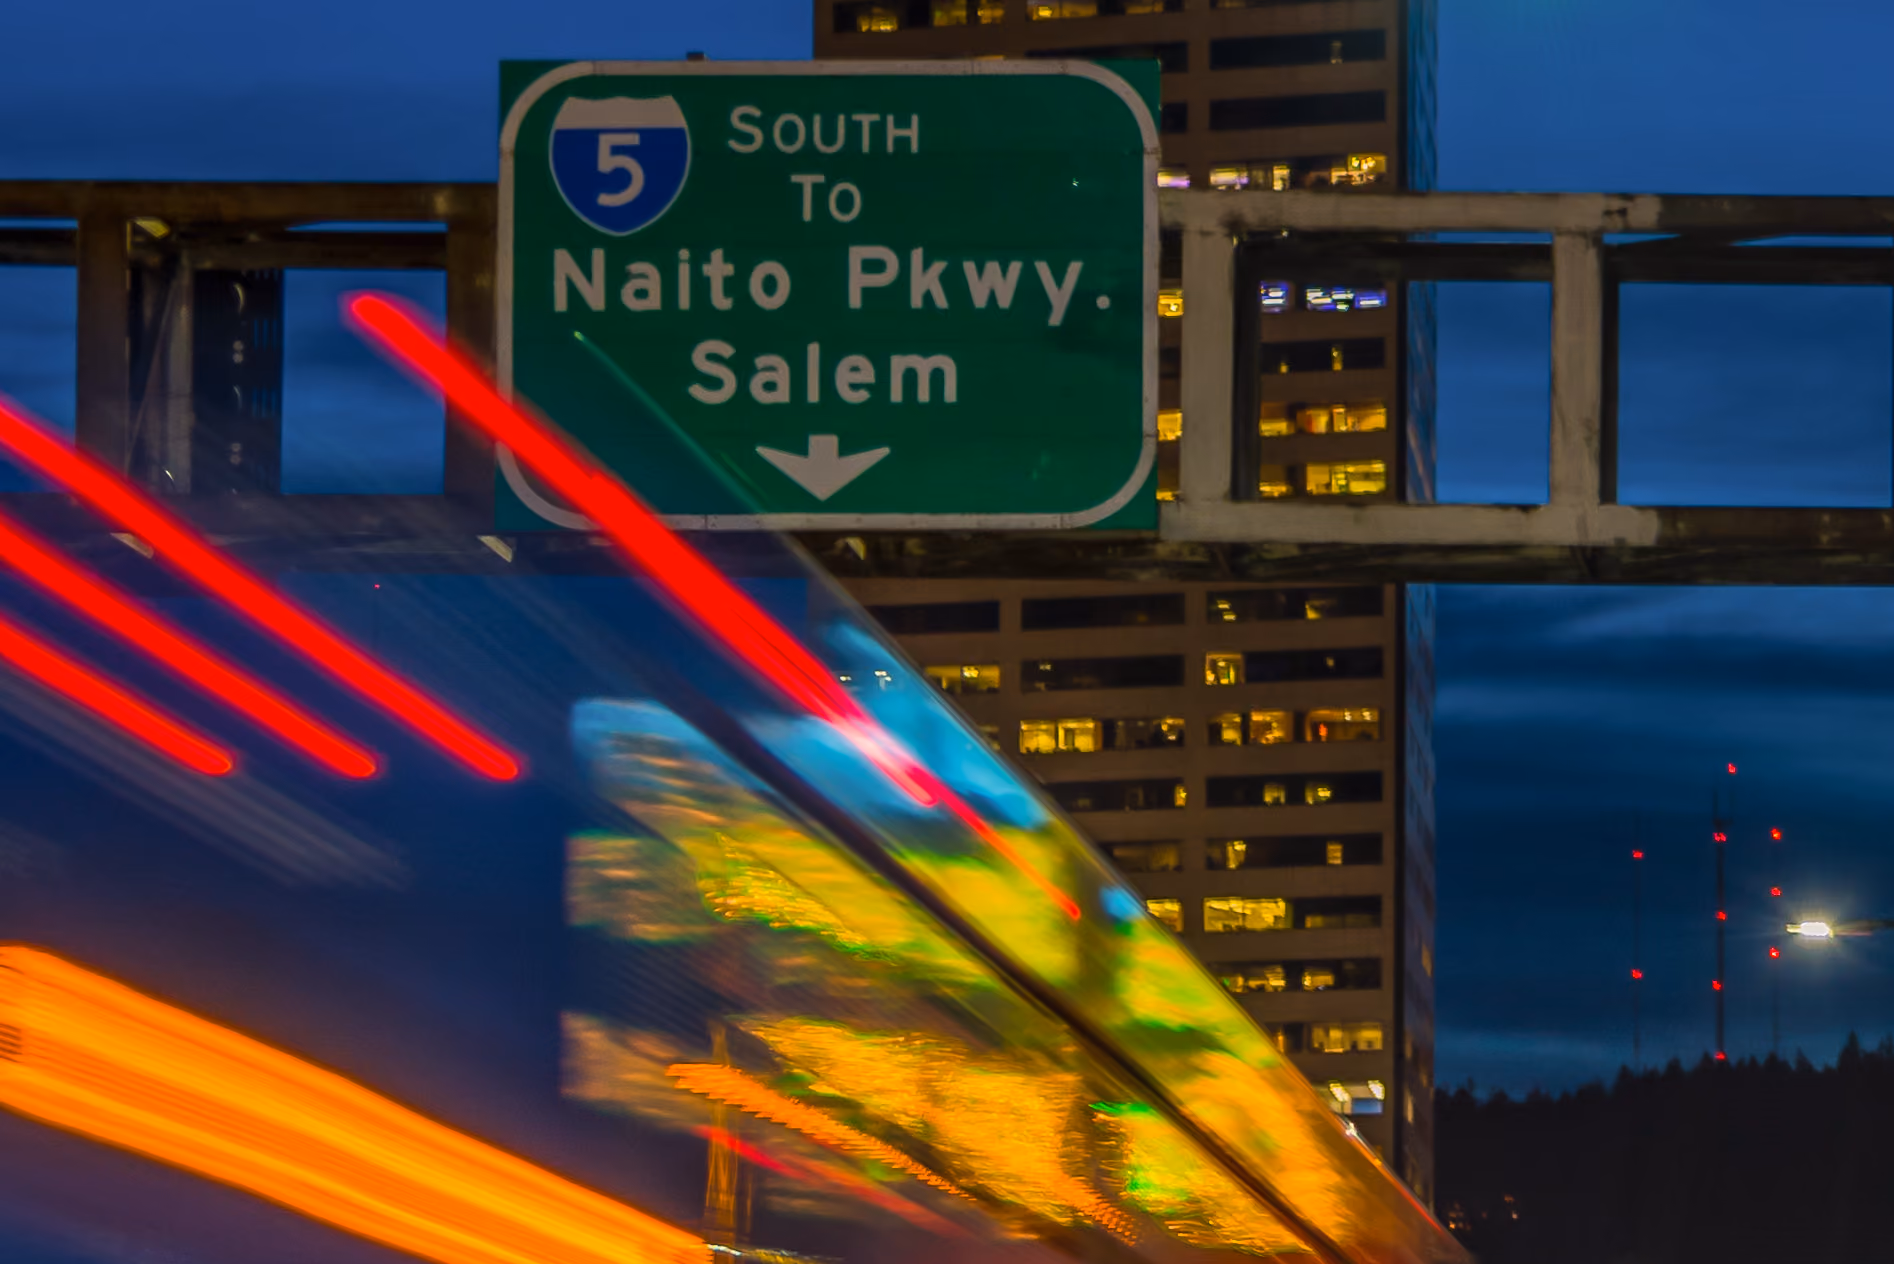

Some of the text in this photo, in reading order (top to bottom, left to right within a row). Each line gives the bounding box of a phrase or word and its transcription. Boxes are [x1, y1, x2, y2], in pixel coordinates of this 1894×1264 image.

[727, 105, 920, 154] SOUTH
[595, 132, 645, 207] 5
[552, 245, 1111, 326] Naito Pkwy.
[687, 339, 958, 405] Salem
